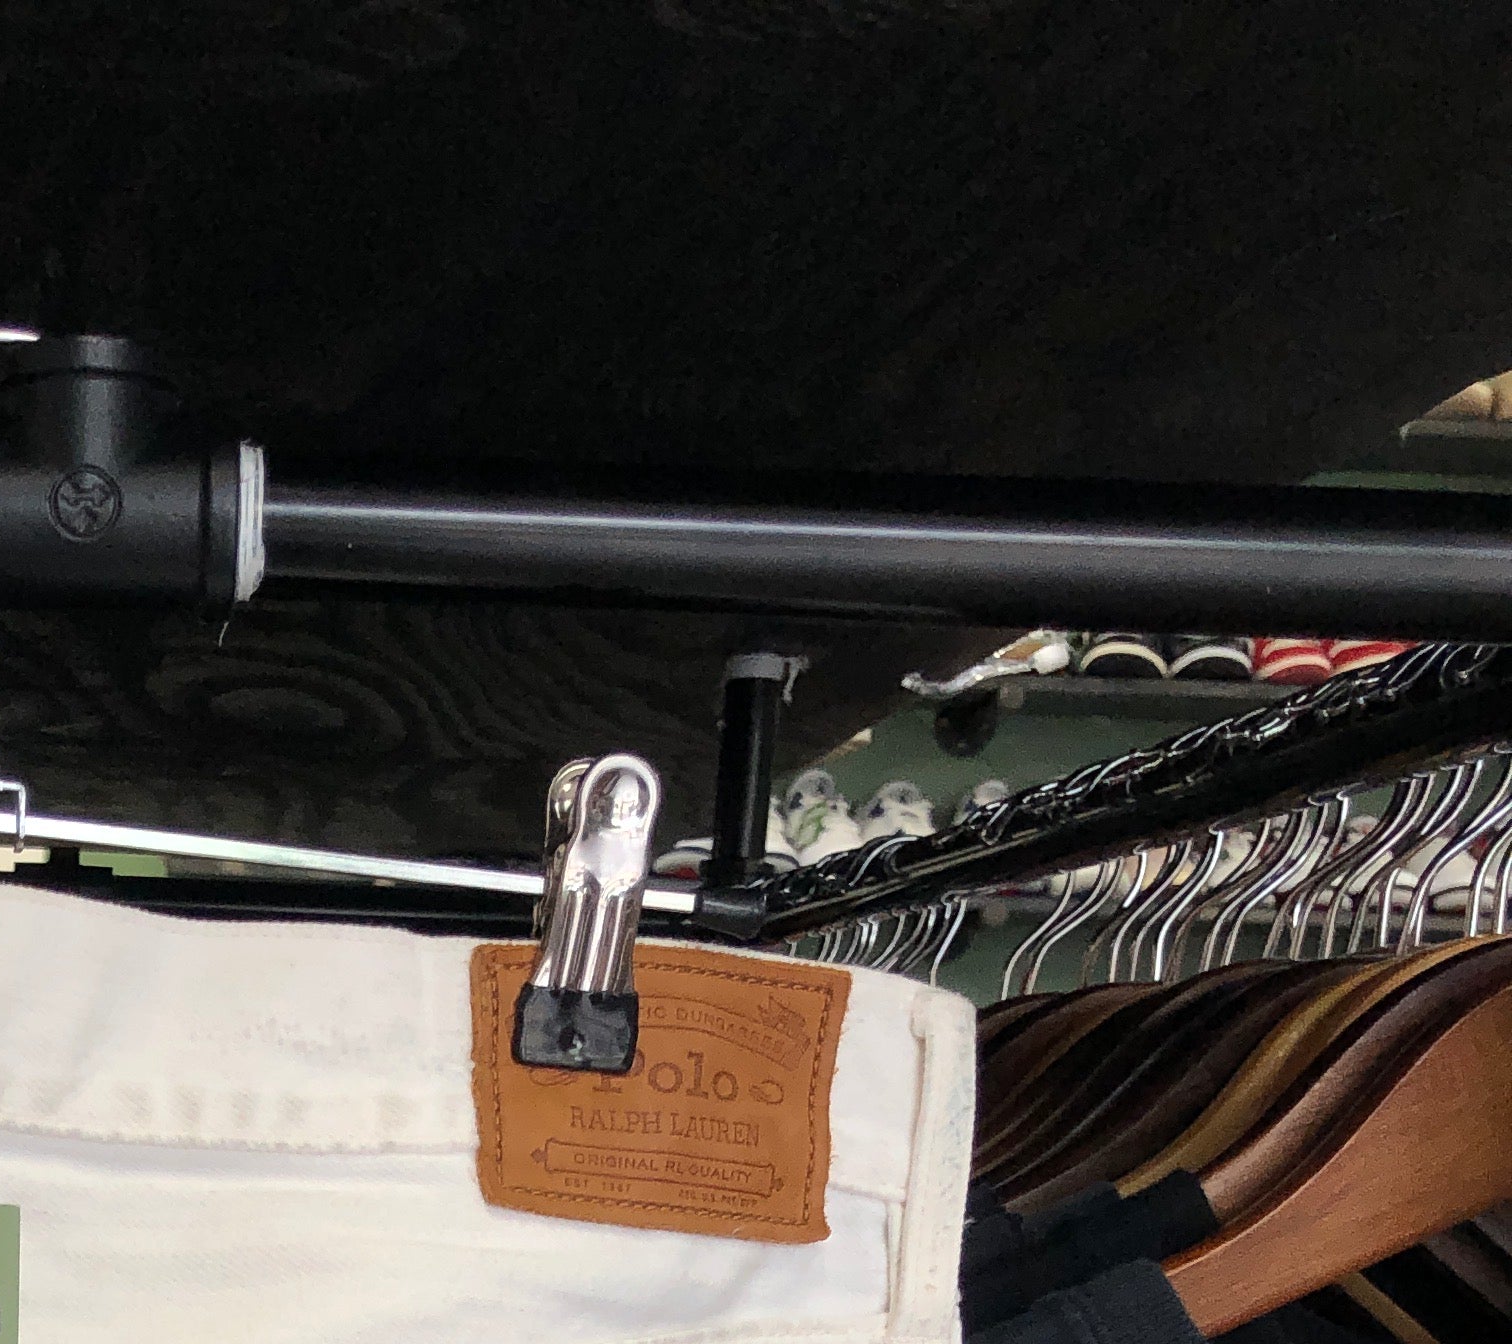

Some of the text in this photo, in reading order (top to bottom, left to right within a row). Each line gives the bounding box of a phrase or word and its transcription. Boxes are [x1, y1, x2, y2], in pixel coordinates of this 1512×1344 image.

[570, 1105, 760, 1148] RALPH LAUREN
[573, 1152, 659, 1172] ORIGINAL
[687, 1163, 752, 1183] QUALITY
